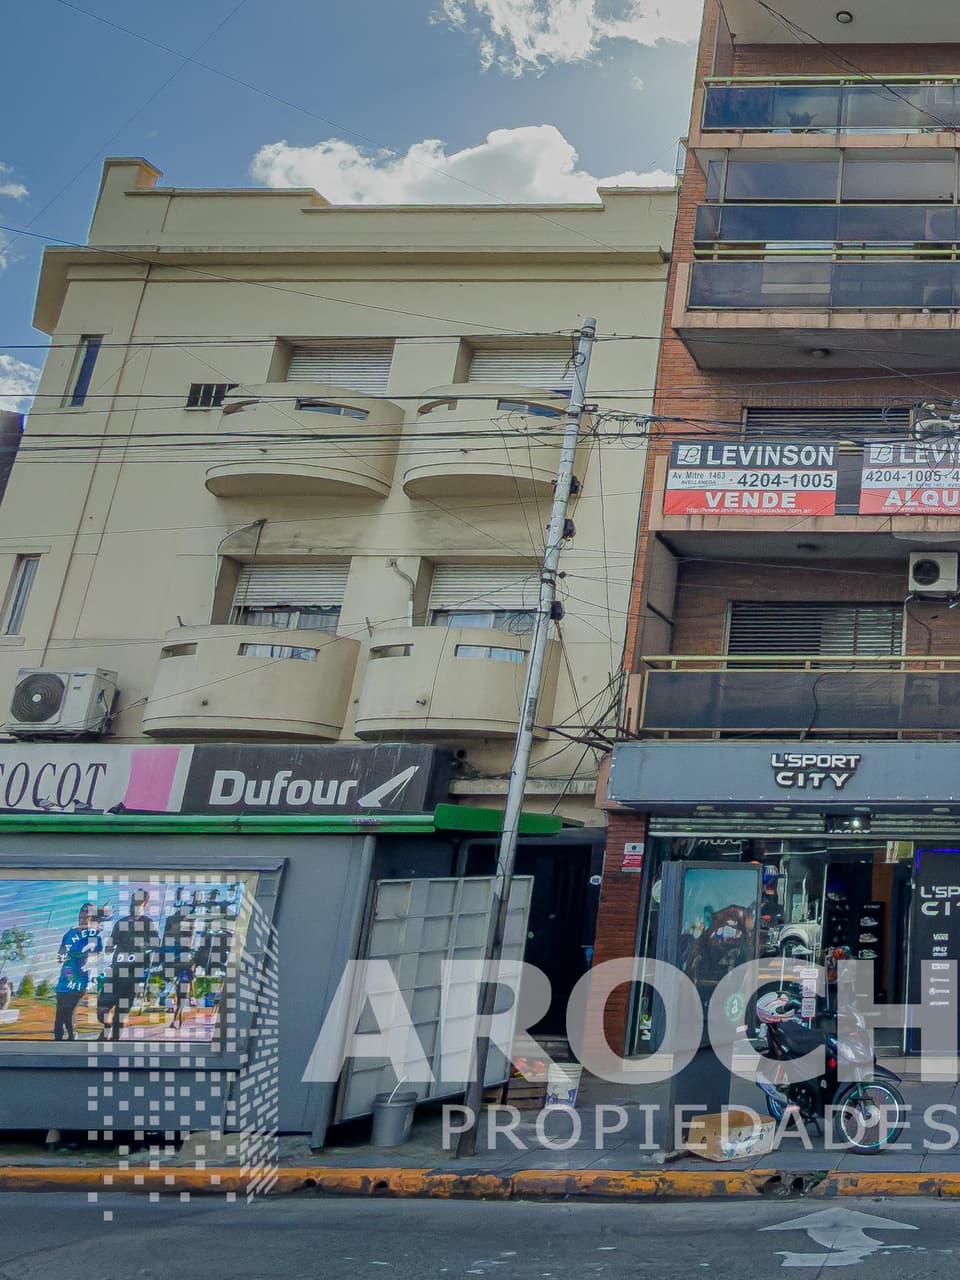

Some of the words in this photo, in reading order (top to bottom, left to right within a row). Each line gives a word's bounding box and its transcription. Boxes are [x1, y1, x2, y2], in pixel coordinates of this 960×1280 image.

[706, 445, 834, 466] LEVINSON
[685, 471, 705, 480] Mitre
[737, 473, 834, 488] 4204-1005
[865, 470, 942, 483] 4204-1005
[705, 491, 797, 508] VENDE
[771, 754, 861, 769] L'SPORT
[0, 761, 107, 809] OCOT
[775, 771, 850, 787] CITY
[208, 770, 358, 806] Dufour
